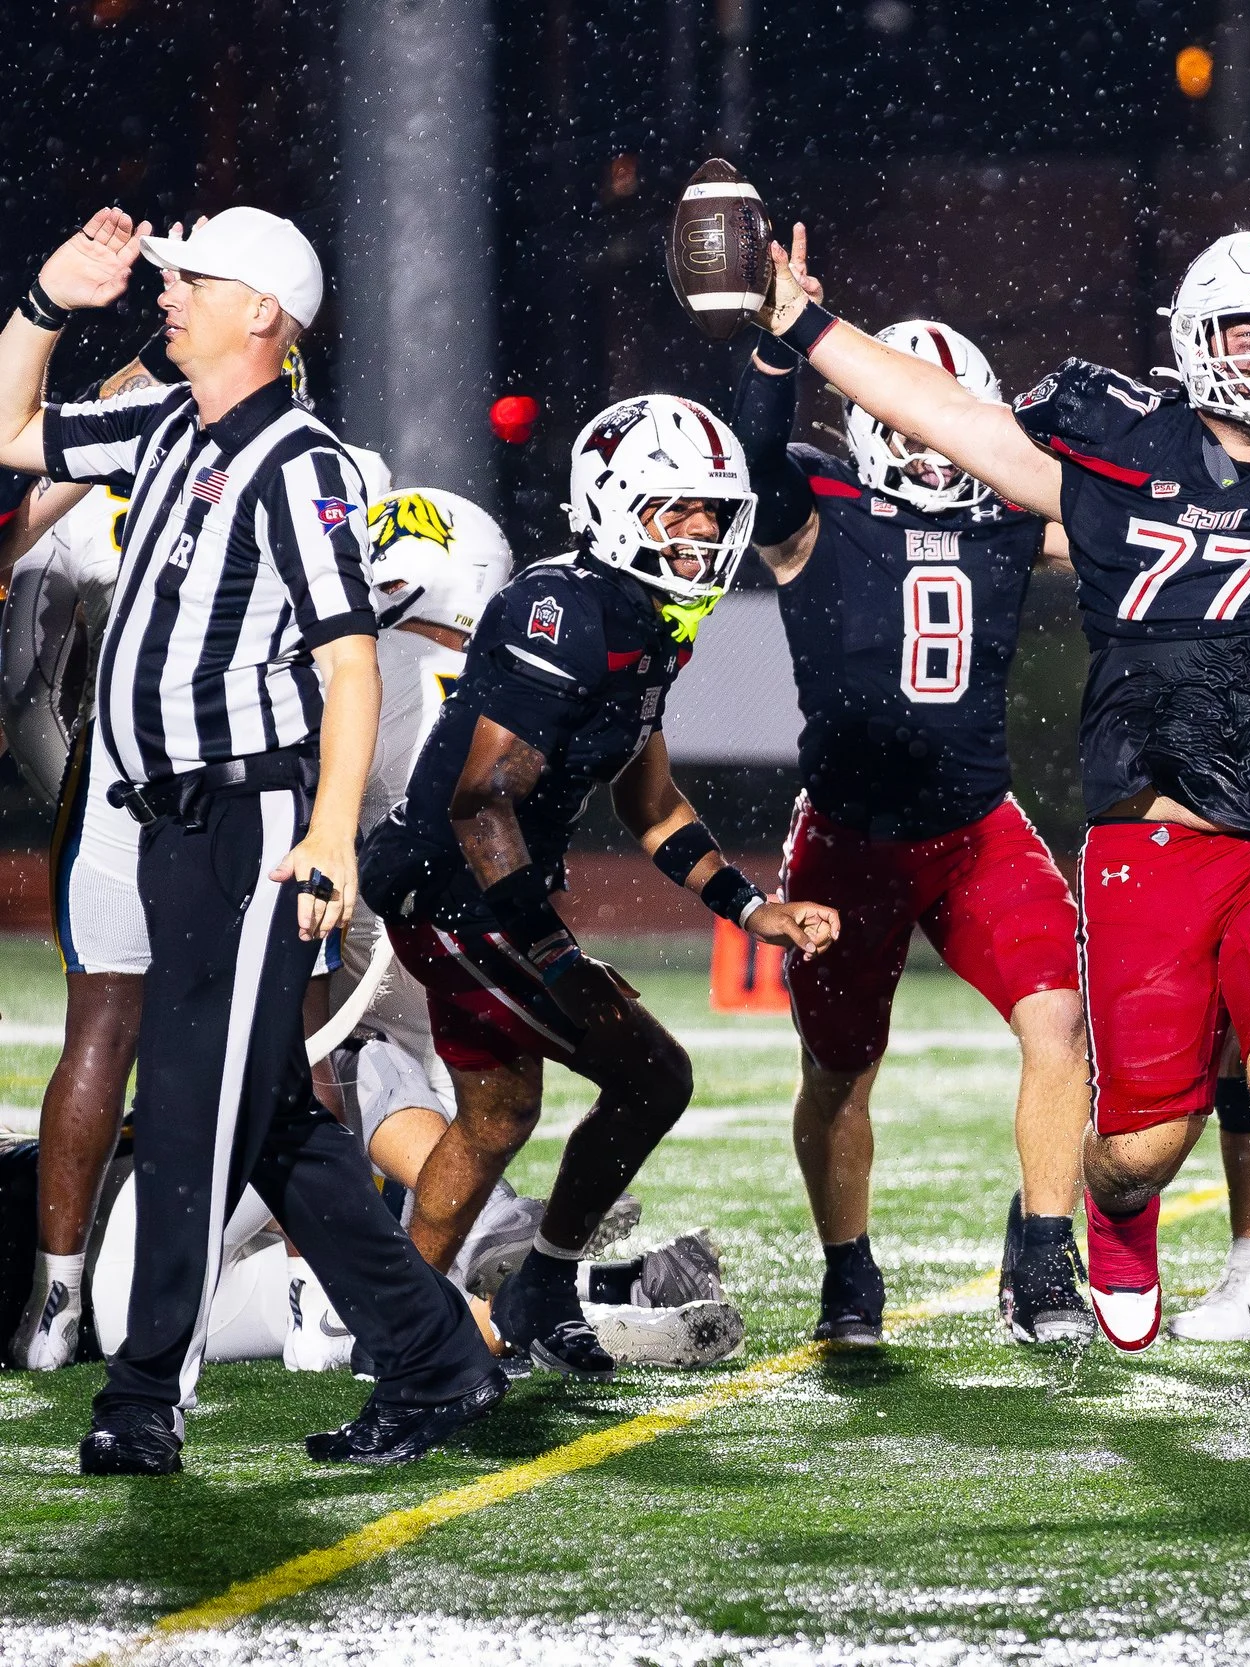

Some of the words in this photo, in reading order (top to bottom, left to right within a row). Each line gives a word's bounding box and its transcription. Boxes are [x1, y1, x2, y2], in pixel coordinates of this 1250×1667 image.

[1177, 504, 1248, 530] ESU
[168, 532, 194, 569] R
[904, 529, 963, 560] ESU
[900, 566, 973, 703] 8
